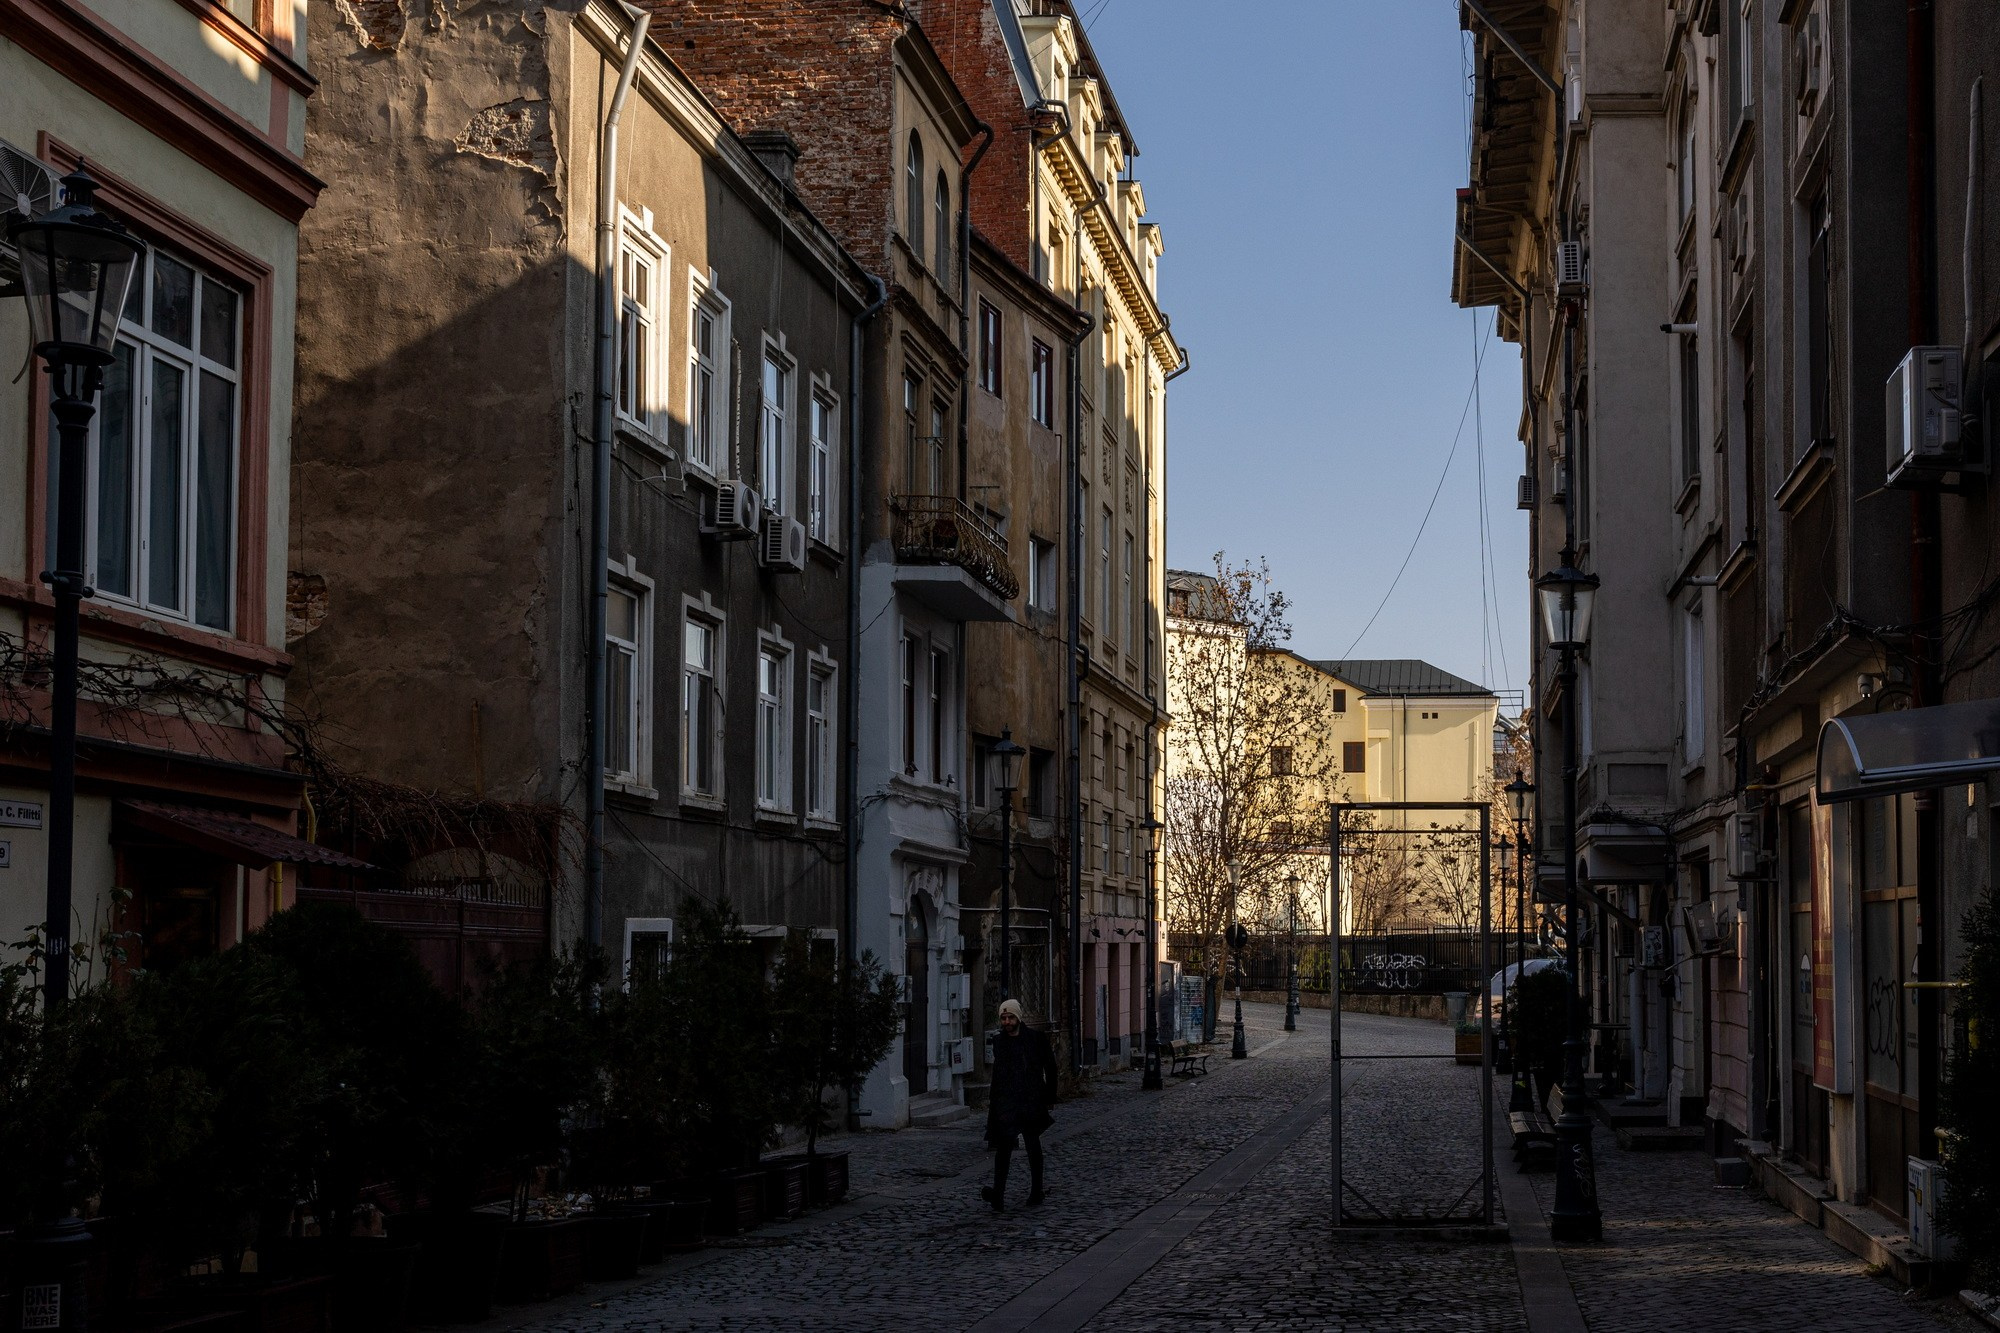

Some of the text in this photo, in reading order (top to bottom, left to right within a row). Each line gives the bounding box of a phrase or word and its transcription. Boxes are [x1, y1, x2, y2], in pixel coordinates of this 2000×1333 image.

[18, 808, 41, 820] Filitti
[25, 1306, 58, 1315] WAS
[25, 1316, 57, 1327] HERE
